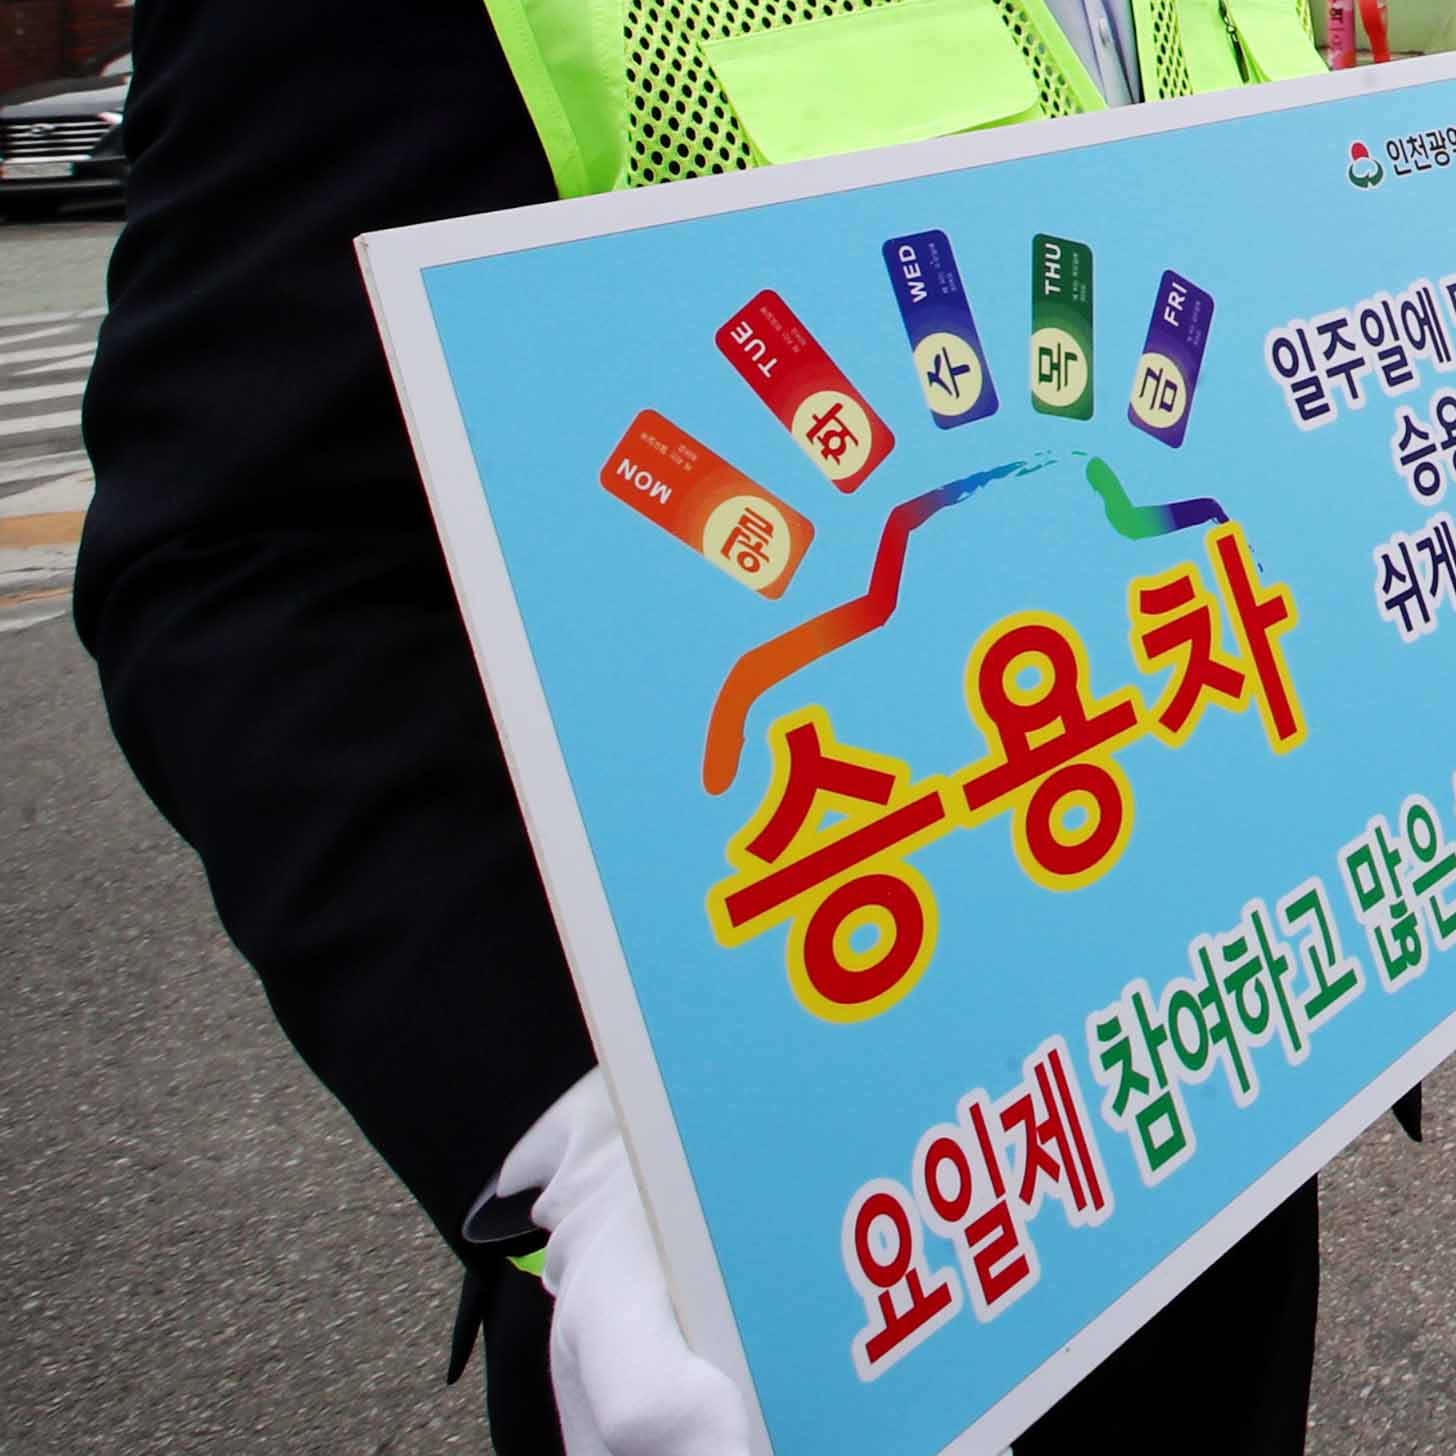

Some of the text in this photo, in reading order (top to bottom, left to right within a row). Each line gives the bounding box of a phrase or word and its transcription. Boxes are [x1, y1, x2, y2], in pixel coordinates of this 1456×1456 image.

[898, 244, 928, 303] WED
[1045, 243, 1062, 296] THU
[1163, 281, 1188, 327] FRI
[729, 320, 779, 378] TUE
[927, 346, 971, 399] 수
[1038, 342, 1078, 392] 목
[1271, 284, 1452, 423] 일주일에
[1139, 367, 1178, 413] 금
[806, 401, 860, 464] 화
[616, 458, 672, 505] MON
[720, 506, 775, 574] 월
[717, 528, 1301, 1012] 승용차
[852, 1047, 1106, 1366] 요일제
[1098, 889, 1359, 1174] 참여하고
